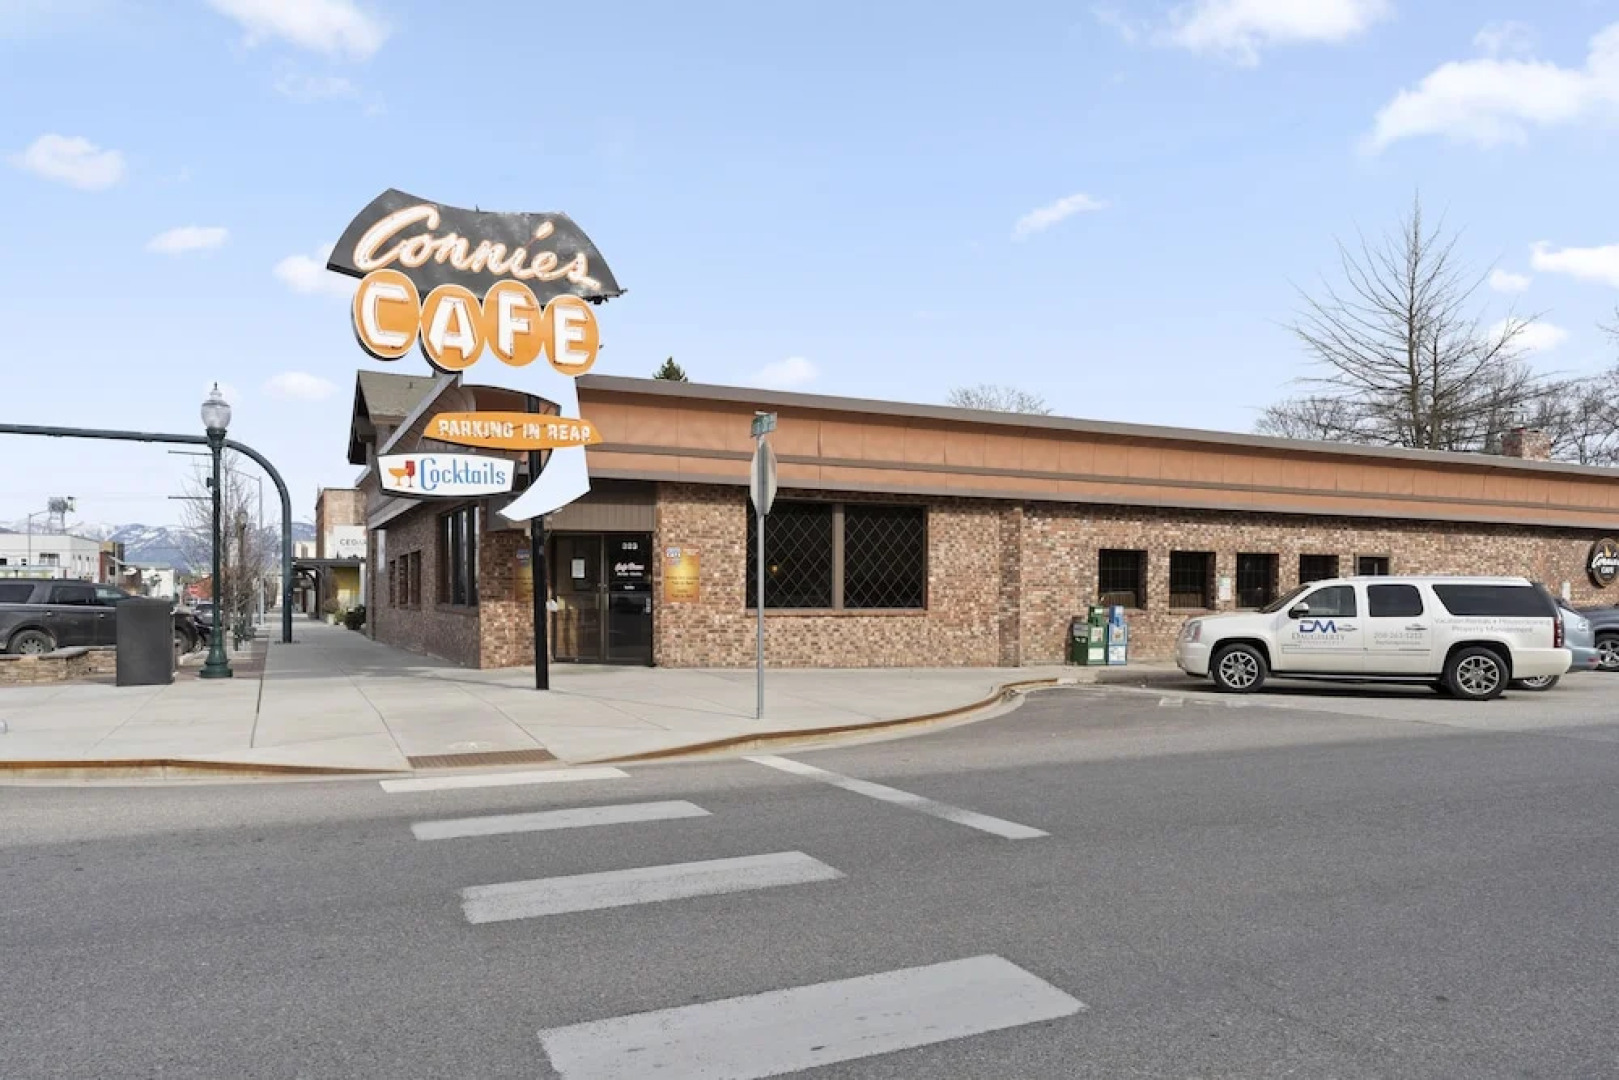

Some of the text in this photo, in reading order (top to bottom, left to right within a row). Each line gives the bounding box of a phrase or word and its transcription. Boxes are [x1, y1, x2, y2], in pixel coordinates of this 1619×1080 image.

[361, 281, 591, 367] CAFE
[437, 418, 514, 439] PARKING
[522, 422, 541, 440] IN
[420, 457, 506, 491] Cocktails
[1299, 619, 1337, 634] DM
